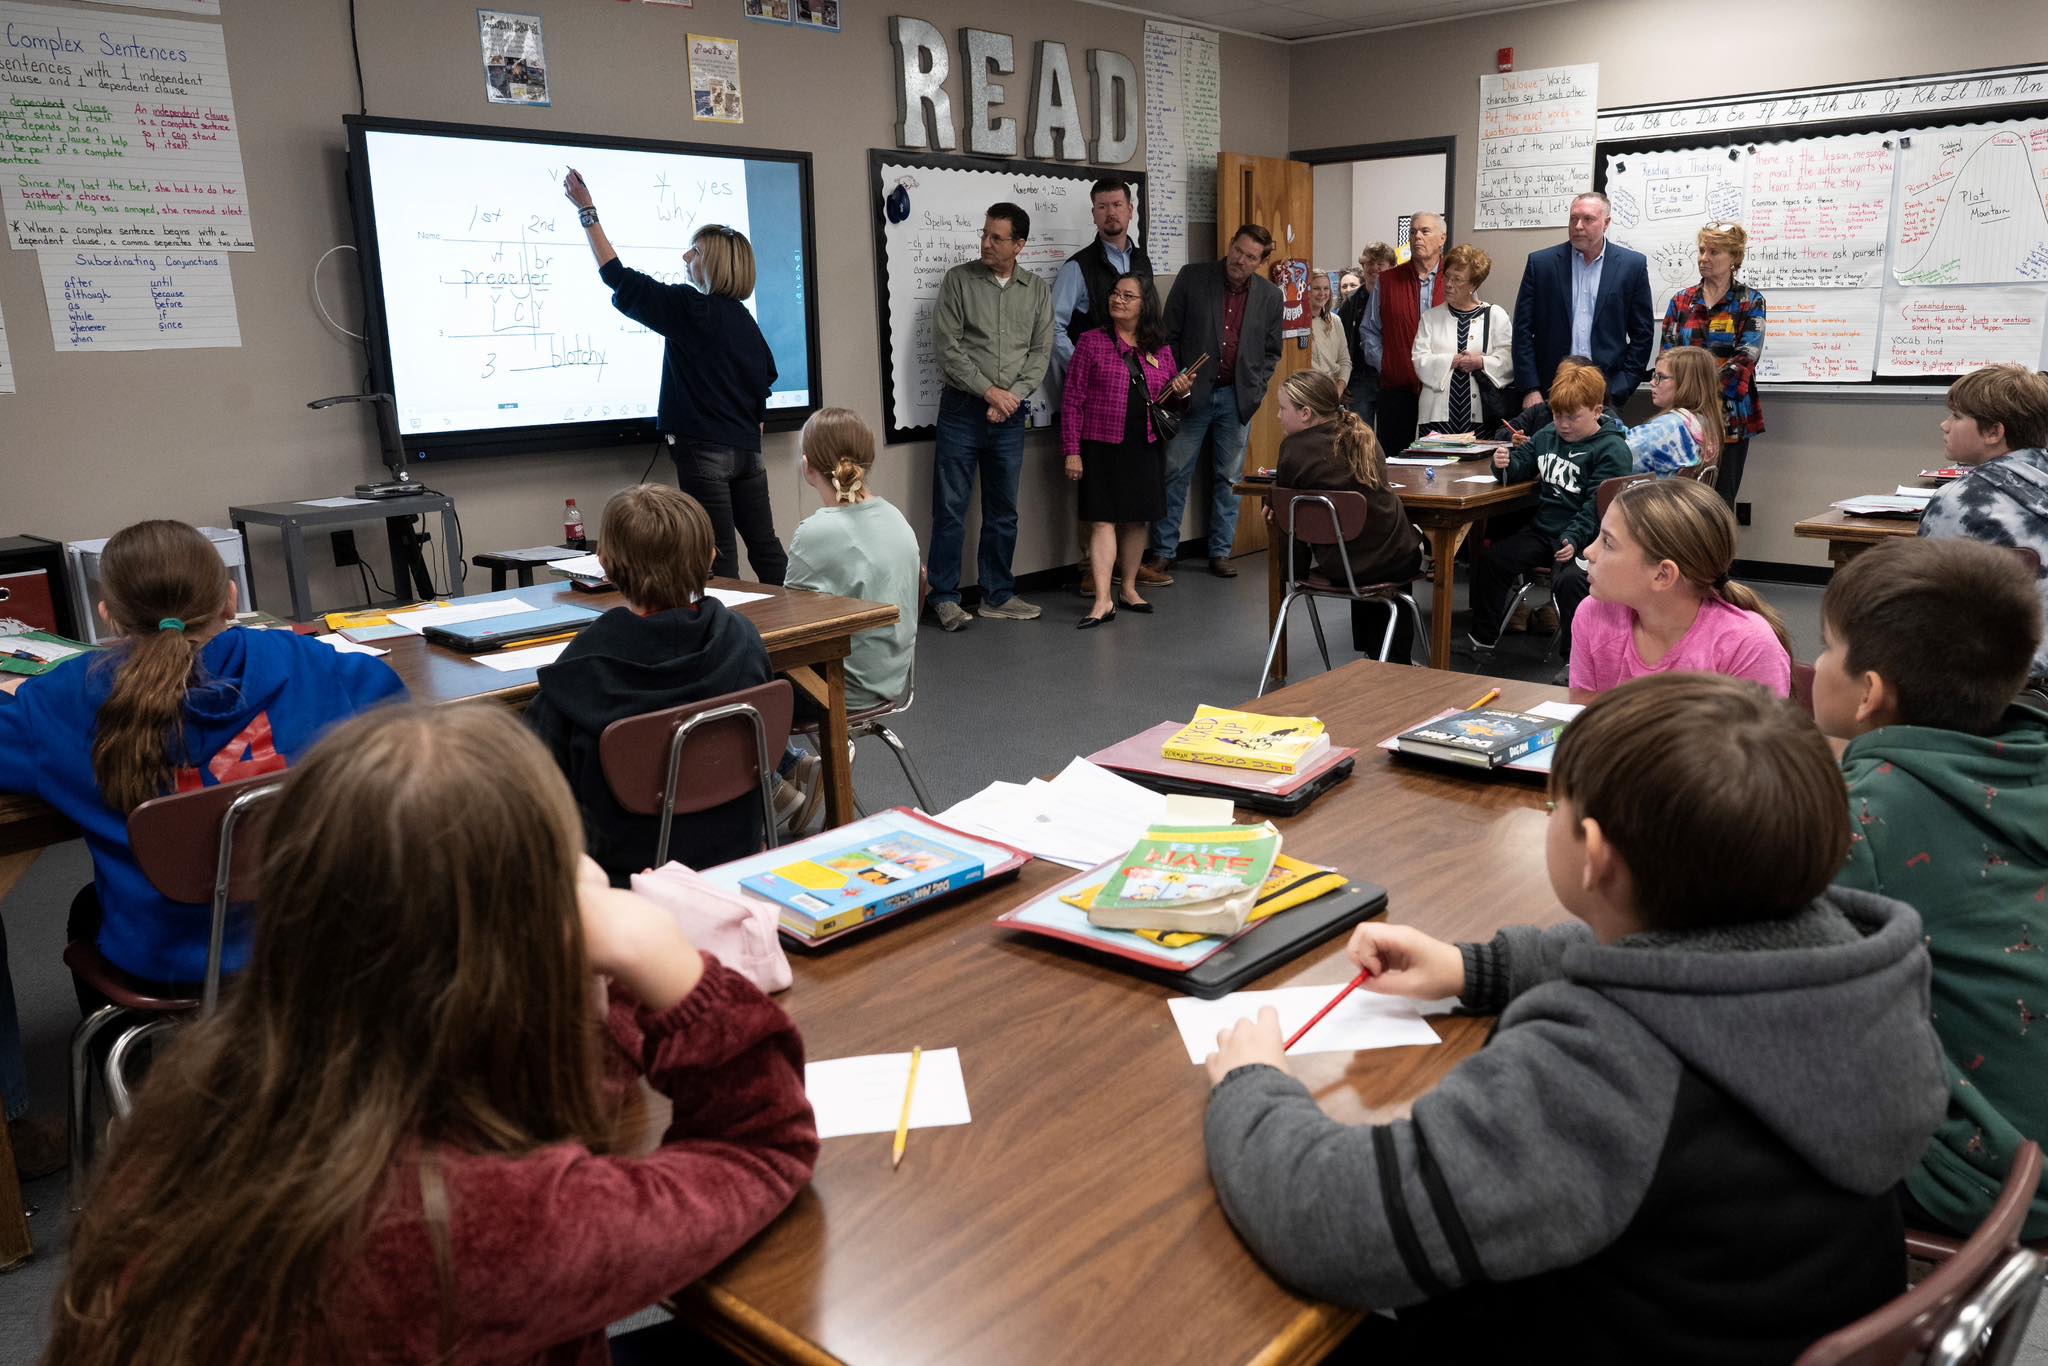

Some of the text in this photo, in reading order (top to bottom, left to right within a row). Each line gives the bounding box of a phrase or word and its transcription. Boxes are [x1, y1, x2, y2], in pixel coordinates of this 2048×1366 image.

[7, 23, 187, 62] Complex Sentences
[84, 61, 111, 78] with
[122, 62, 131, 80] 1
[140, 67, 202, 86] independent
[1, 71, 149, 93] clause and dependent
[1503, 71, 1571, 91] Dialogue Words
[888, 15, 1139, 164] READ
[1486, 88, 1562, 105] characters say each
[10, 93, 107, 112] dependent clause
[1614, 76, 2043, 132] Aa Bb Cc Dd Ee Ff Gg Hh Ii Jj Kk Ll Mm Nn
[135, 102, 230, 120] An independent clause
[1500, 138, 1544, 152] out of the
[1849, 158, 1875, 174] wants
[1880, 164, 1893, 174] you
[18, 174, 52, 187] Since
[81, 179, 100, 190] lost
[108, 178, 124, 190] the
[155, 181, 171, 192] she
[173, 182, 190, 193] had
[194, 183, 203, 193] to
[207, 184, 217, 194] do
[222, 183, 237, 195] her
[1492, 171, 1533, 186] want to go
[1822, 175, 1836, 188] the
[21, 188, 73, 200] brother's
[698, 180, 733, 203] yes
[1013, 183, 1067, 196] November 2025
[1500, 185, 1512, 197] but
[1516, 184, 1529, 198] only
[1533, 182, 1549, 194] with
[1659, 184, 1681, 193] Clues
[1959, 188, 1985, 202] Plot
[25, 200, 69, 215] Although
[75, 201, 97, 216] Meg
[102, 205, 119, 213] was
[162, 203, 179, 214] she
[183, 205, 216, 215] remained
[1035, 202, 1058, 213] 11-4-25
[1500, 201, 1524, 215] Smith
[1752, 197, 1800, 207] Common topics
[657, 191, 697, 230] why
[1655, 205, 1681, 214] Evidence
[1971, 206, 2010, 220] Mountain
[469, 204, 502, 232] 1st
[528, 214, 556, 233] 2nd
[924, 210, 972, 231] Spelling Rules
[1481, 217, 1514, 229] ready for
[23, 220, 216, 239] When complex sentence begins with
[418, 231, 441, 240] Name
[18, 234, 231, 248] dependent comma seperates the two
[939, 235, 952, 249] the
[535, 245, 553, 269] br
[913, 252, 923, 262] of
[1745, 243, 1885, 261] To find the theme ask yourself
[75, 253, 218, 271] Subordinating Conjunctions
[150, 276, 173, 288] until
[461, 251, 549, 299] preacher
[64, 276, 93, 290] after
[917, 278, 923, 289] 2
[65, 289, 111, 303] although
[151, 288, 185, 298] because
[68, 303, 80, 311] as
[155, 299, 184, 310] before
[69, 310, 94, 321] while
[159, 310, 167, 320] if
[1935, 315, 1945, 323] the
[2002, 314, 2031, 324] mentions
[69, 323, 107, 333] whenever
[159, 321, 184, 331] since
[1911, 325, 1941, 333] something
[70, 334, 94, 344] when
[1928, 336, 1944, 345] hint
[551, 334, 606, 383] blotchy
[1920, 348, 1943, 356] ahead
[481, 353, 497, 379] 3
[1537, 453, 1581, 493] NIKE
[1145, 847, 1254, 875] NATE
